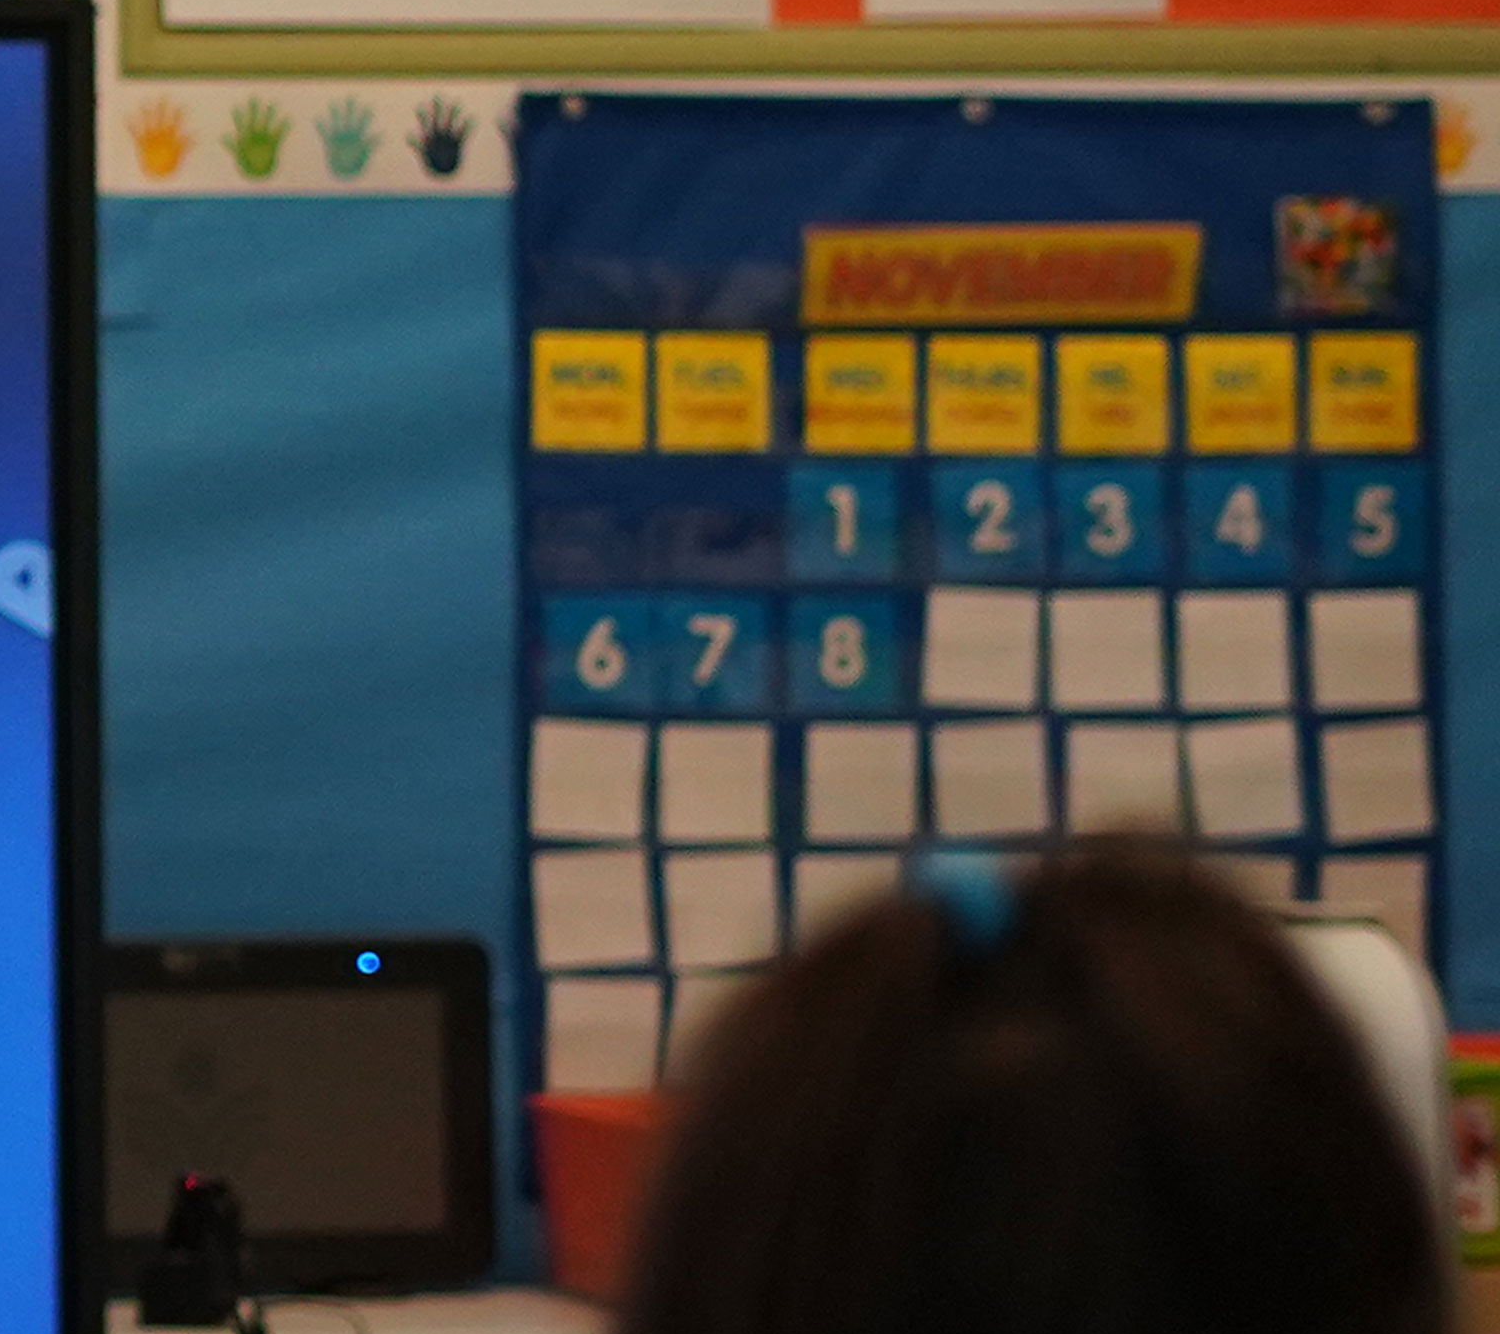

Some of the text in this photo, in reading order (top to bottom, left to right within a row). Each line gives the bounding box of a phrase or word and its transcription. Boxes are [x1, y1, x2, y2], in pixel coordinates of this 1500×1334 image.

[824, 245, 1180, 307] NOVEMBER
[825, 481, 1398, 558] 1 2 3 4 5
[575, 615, 868, 690] 6 7 8
